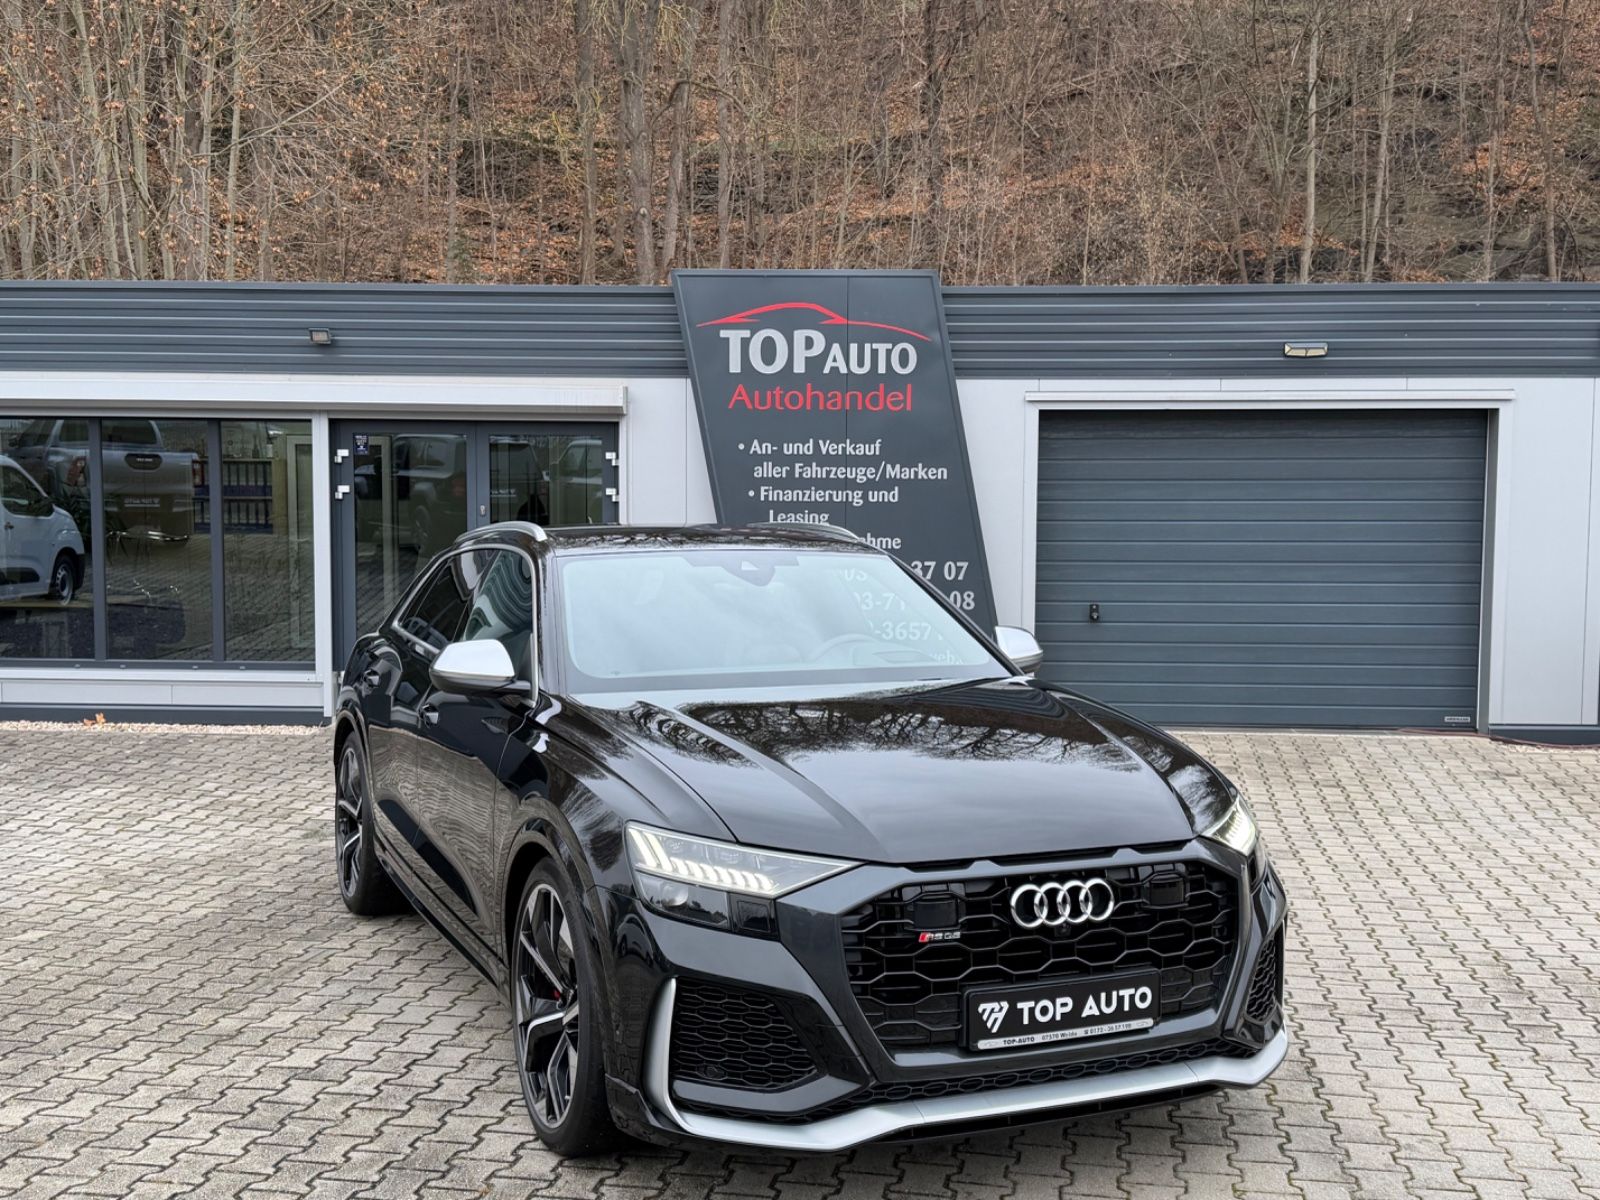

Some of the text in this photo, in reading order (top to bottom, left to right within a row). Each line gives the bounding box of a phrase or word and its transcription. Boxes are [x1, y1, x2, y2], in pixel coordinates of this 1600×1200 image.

[728, 383, 912, 411] Autohandel
[749, 438, 882, 456] An- und Verkauf
[753, 461, 948, 483] aller Fahrzeuge/Marken
[759, 486, 899, 506] Finanzierung und
[769, 510, 830, 524] Leasing
[943, 561, 969, 580] 07
[949, 590, 975, 610] 08
[1016, 986, 1153, 1025] TOP AUTO
[1003, 1036, 1035, 1046] TOP-AUTO
